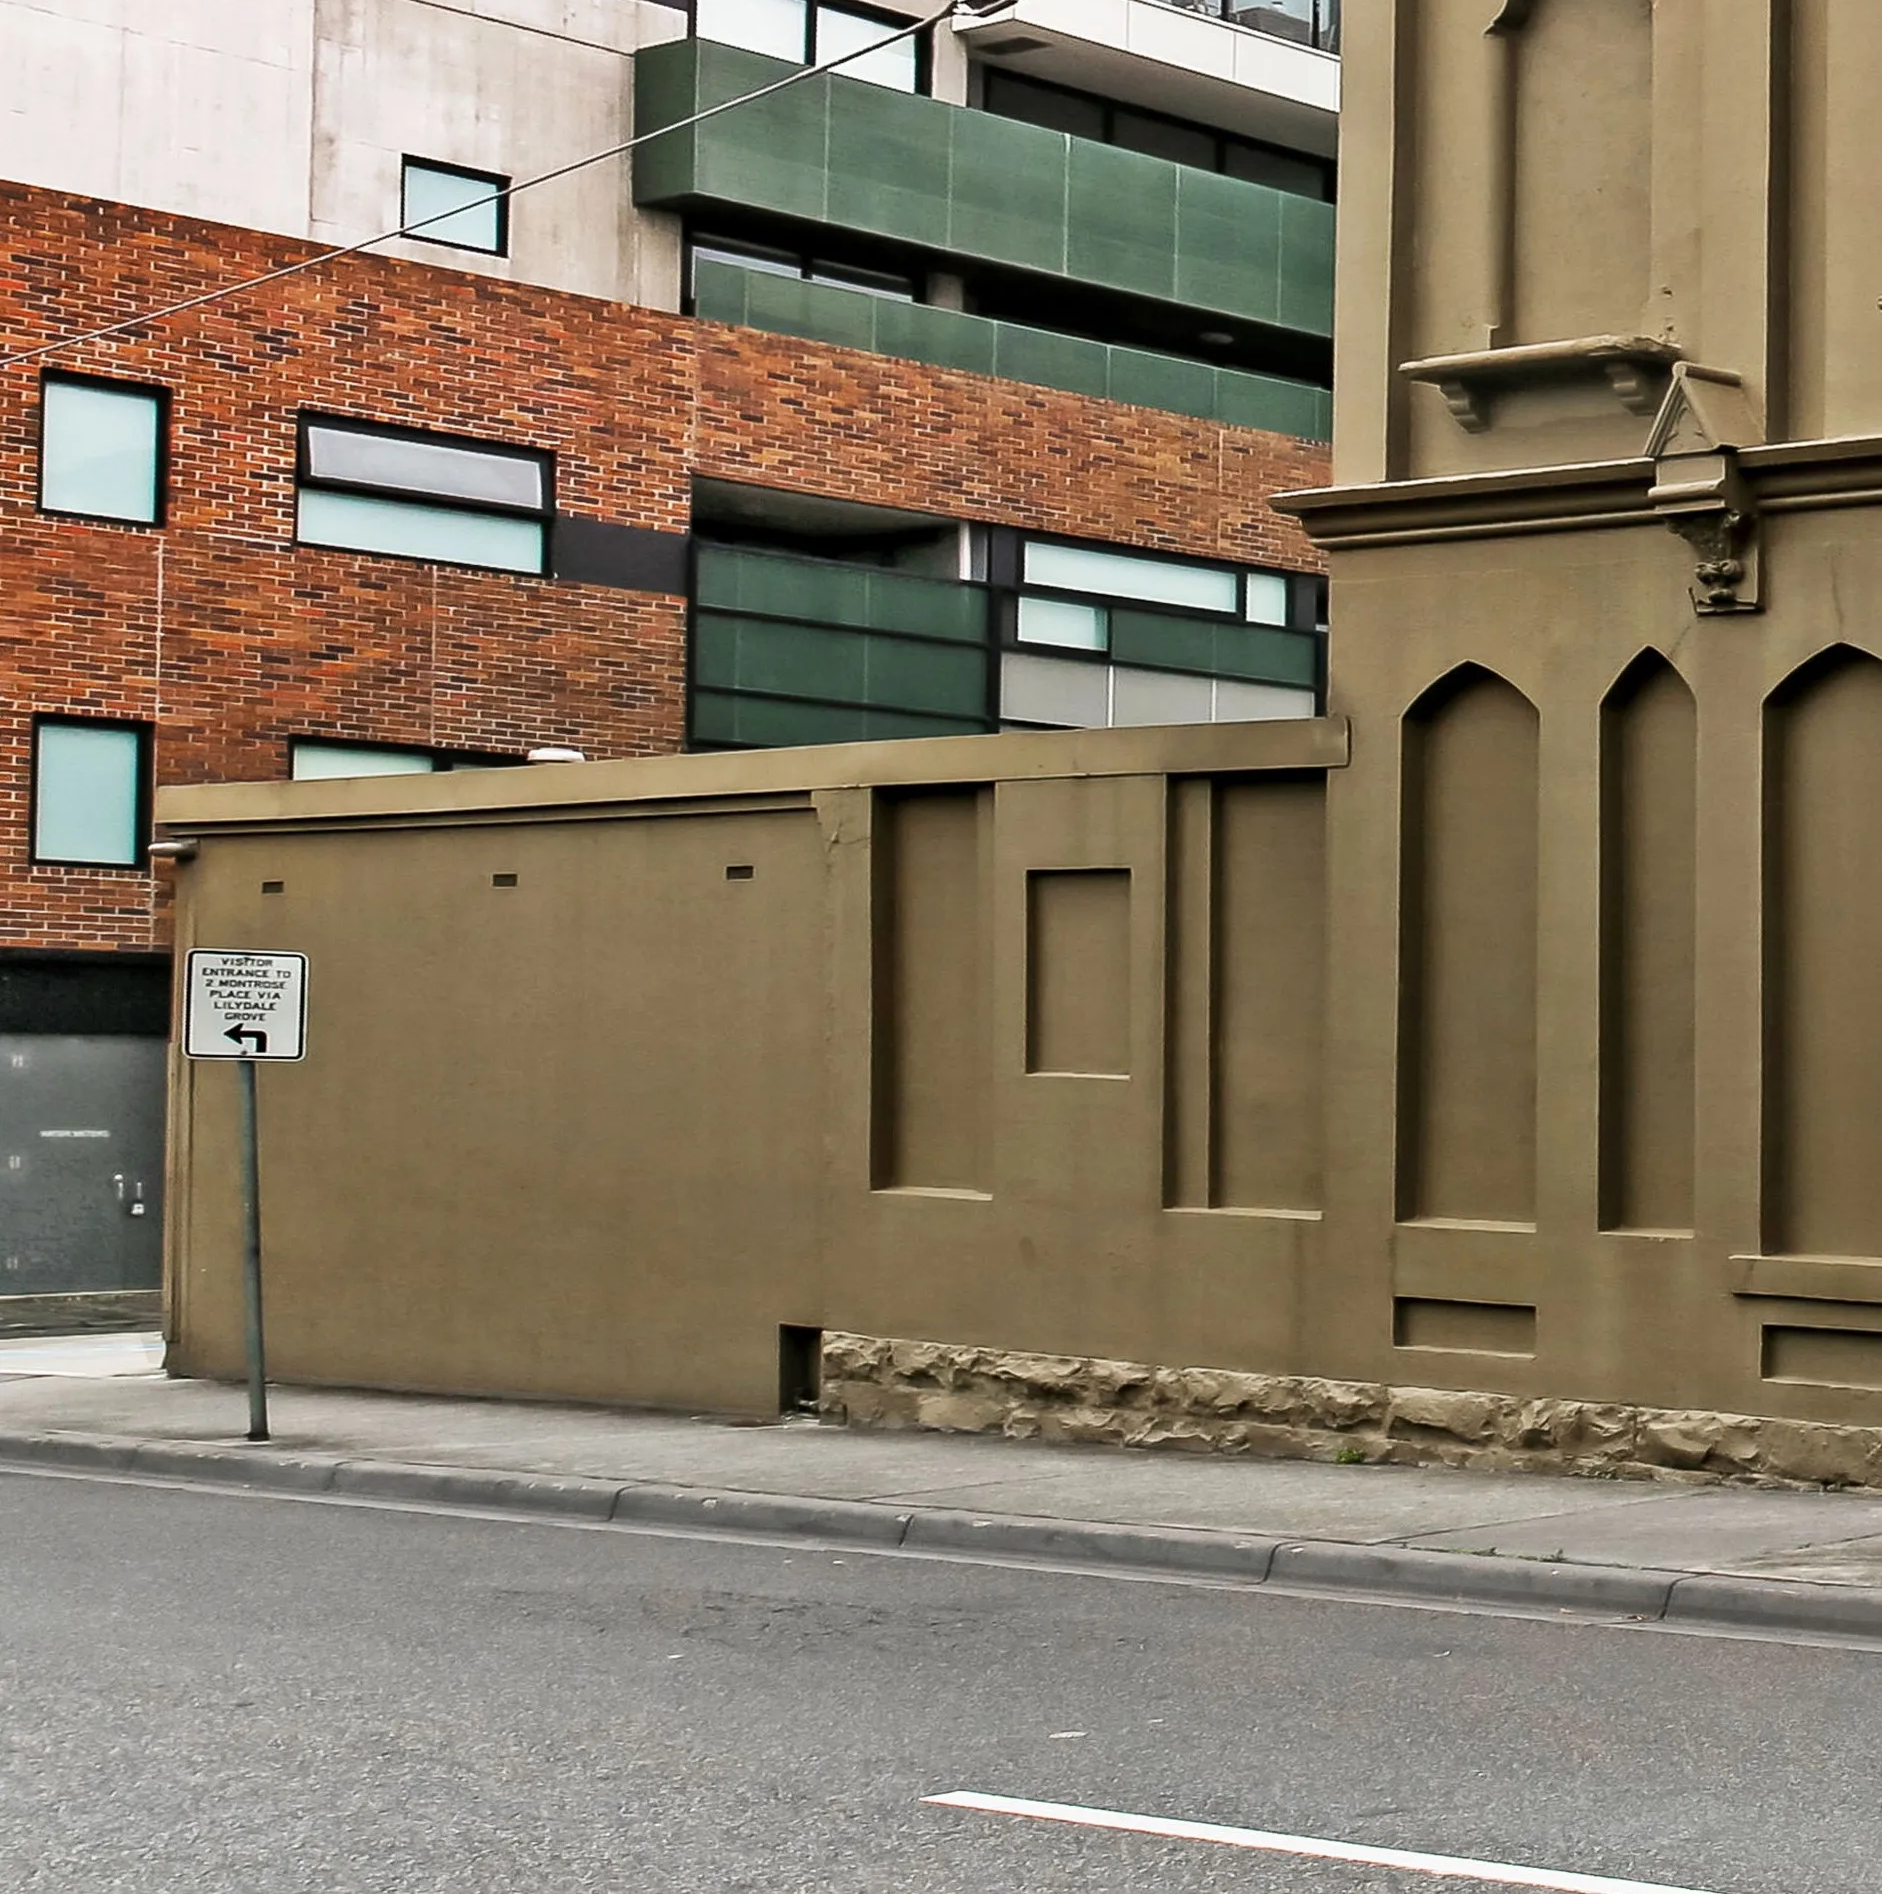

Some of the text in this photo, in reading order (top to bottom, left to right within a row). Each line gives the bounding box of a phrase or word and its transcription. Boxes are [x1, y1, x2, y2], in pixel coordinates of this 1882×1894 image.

[221, 957, 273, 967] VISITOR
[202, 968, 291, 979] ENTRANCE TO
[219, 979, 286, 989] MONTROSE
[209, 990, 251, 999] PLACE
[214, 1002, 277, 1011] LILYDALE
[224, 1012, 266, 1021] GROVE
